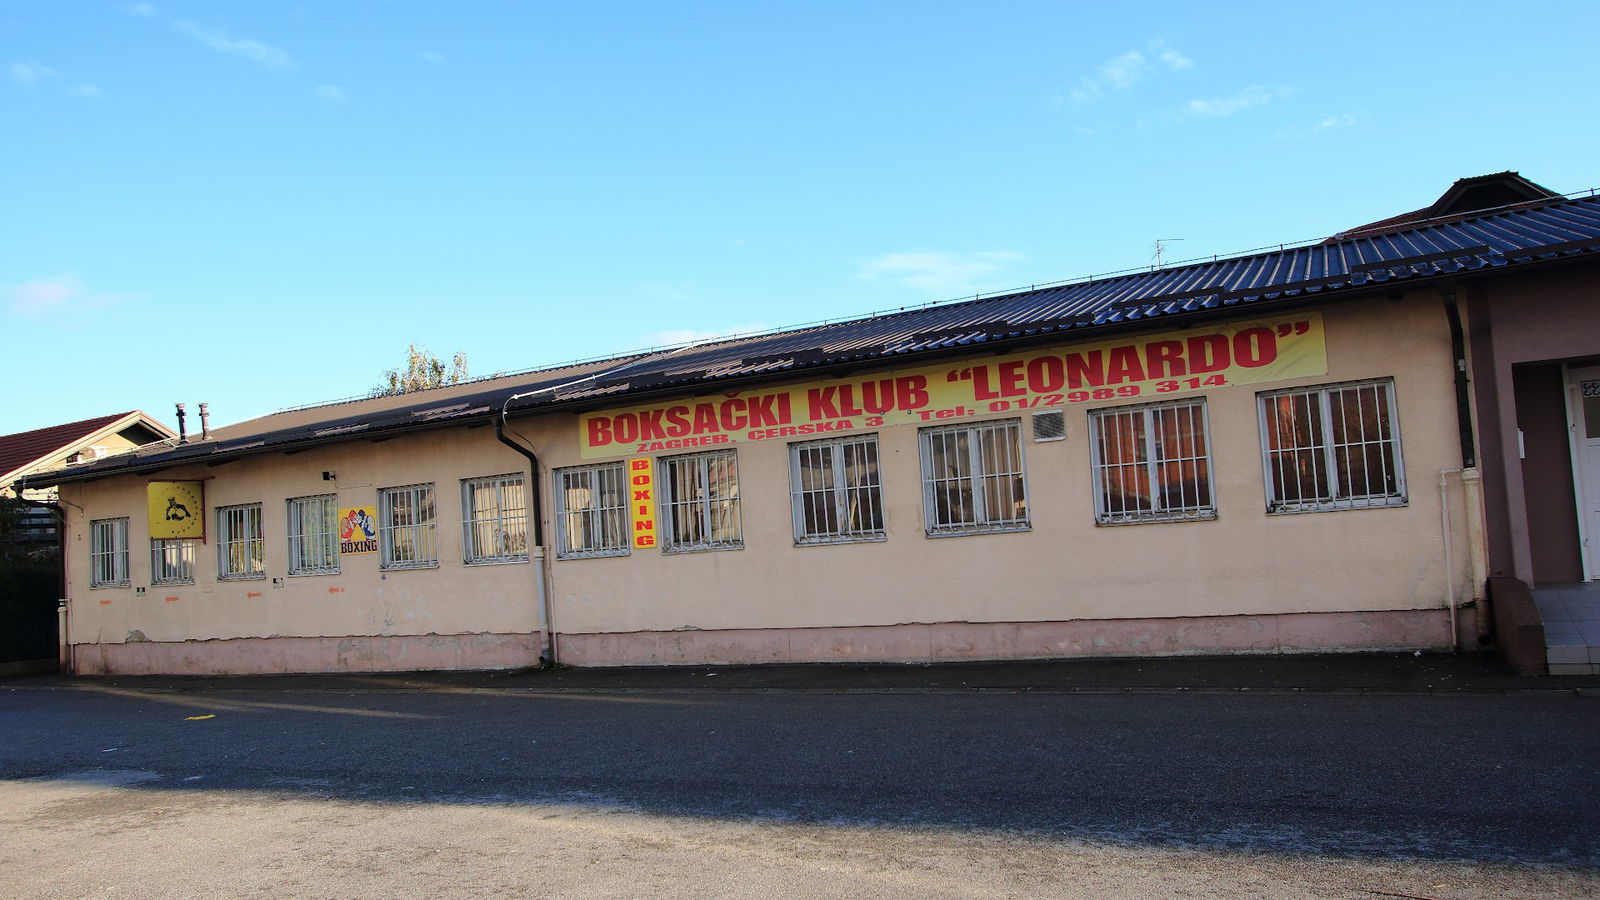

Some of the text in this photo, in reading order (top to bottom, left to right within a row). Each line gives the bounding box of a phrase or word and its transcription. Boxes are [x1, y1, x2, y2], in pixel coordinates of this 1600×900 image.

[587, 391, 792, 447] BOKSAČKI
[807, 374, 929, 421] KLUB
[747, 419, 855, 441] CERSKA
[864, 416, 884, 427] 3
[916, 406, 975, 420] Tel:
[989, 384, 1141, 412] 01/2989
[1155, 374, 1228, 393] 314
[632, 460, 654, 546] BOXING
[341, 540, 378, 554] BOXING
